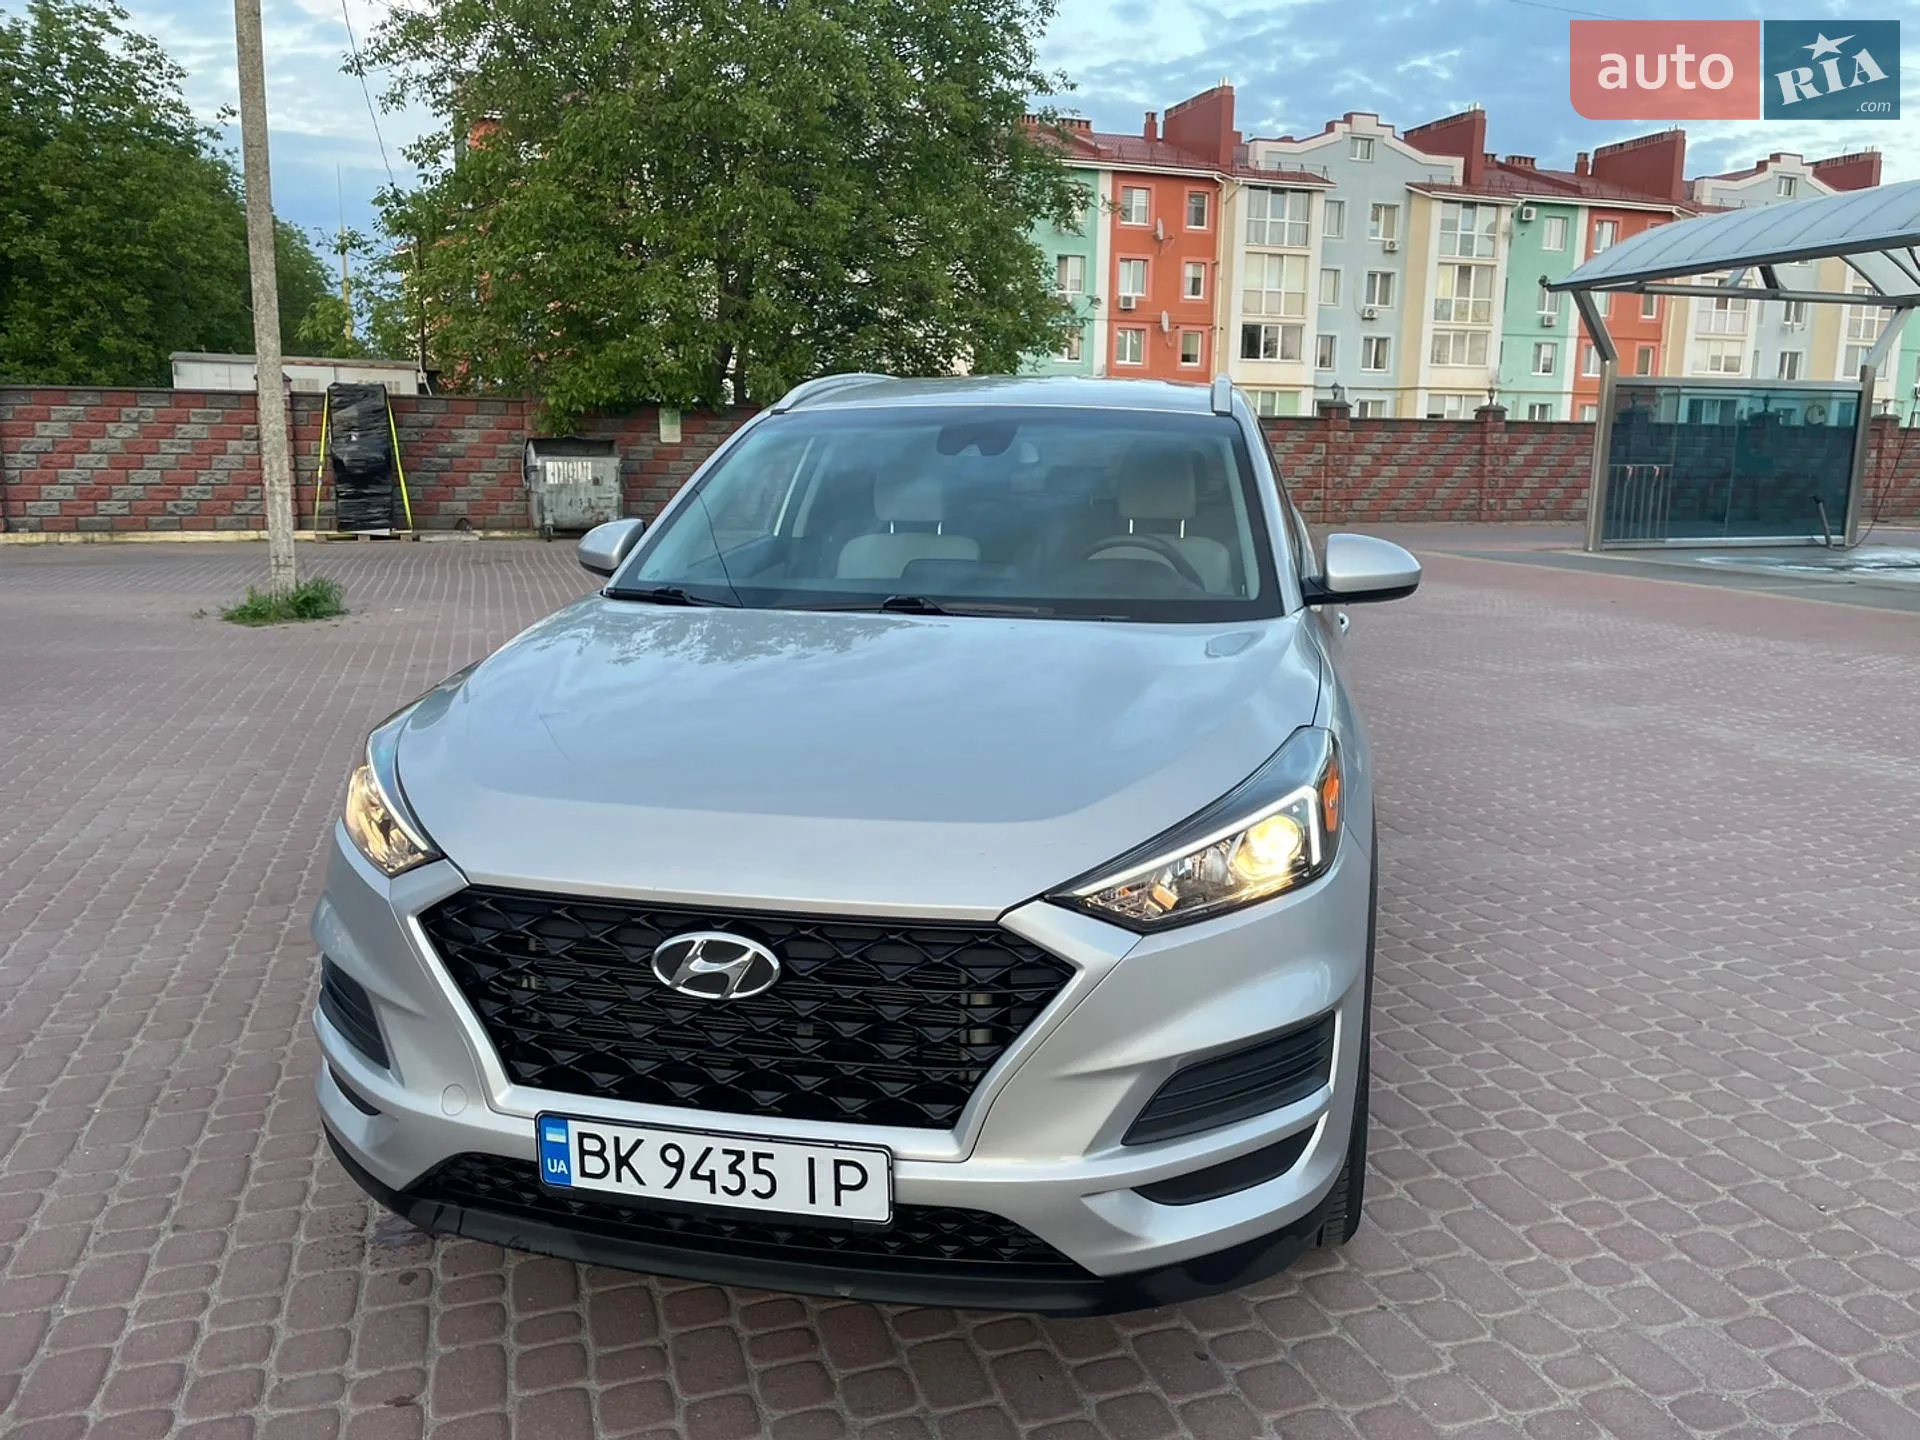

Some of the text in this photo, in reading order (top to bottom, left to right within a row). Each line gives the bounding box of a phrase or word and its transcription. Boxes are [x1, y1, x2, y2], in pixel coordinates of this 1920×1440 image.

[547, 1157, 568, 1175] UA
[577, 1131, 869, 1207] BK 9435 IP
